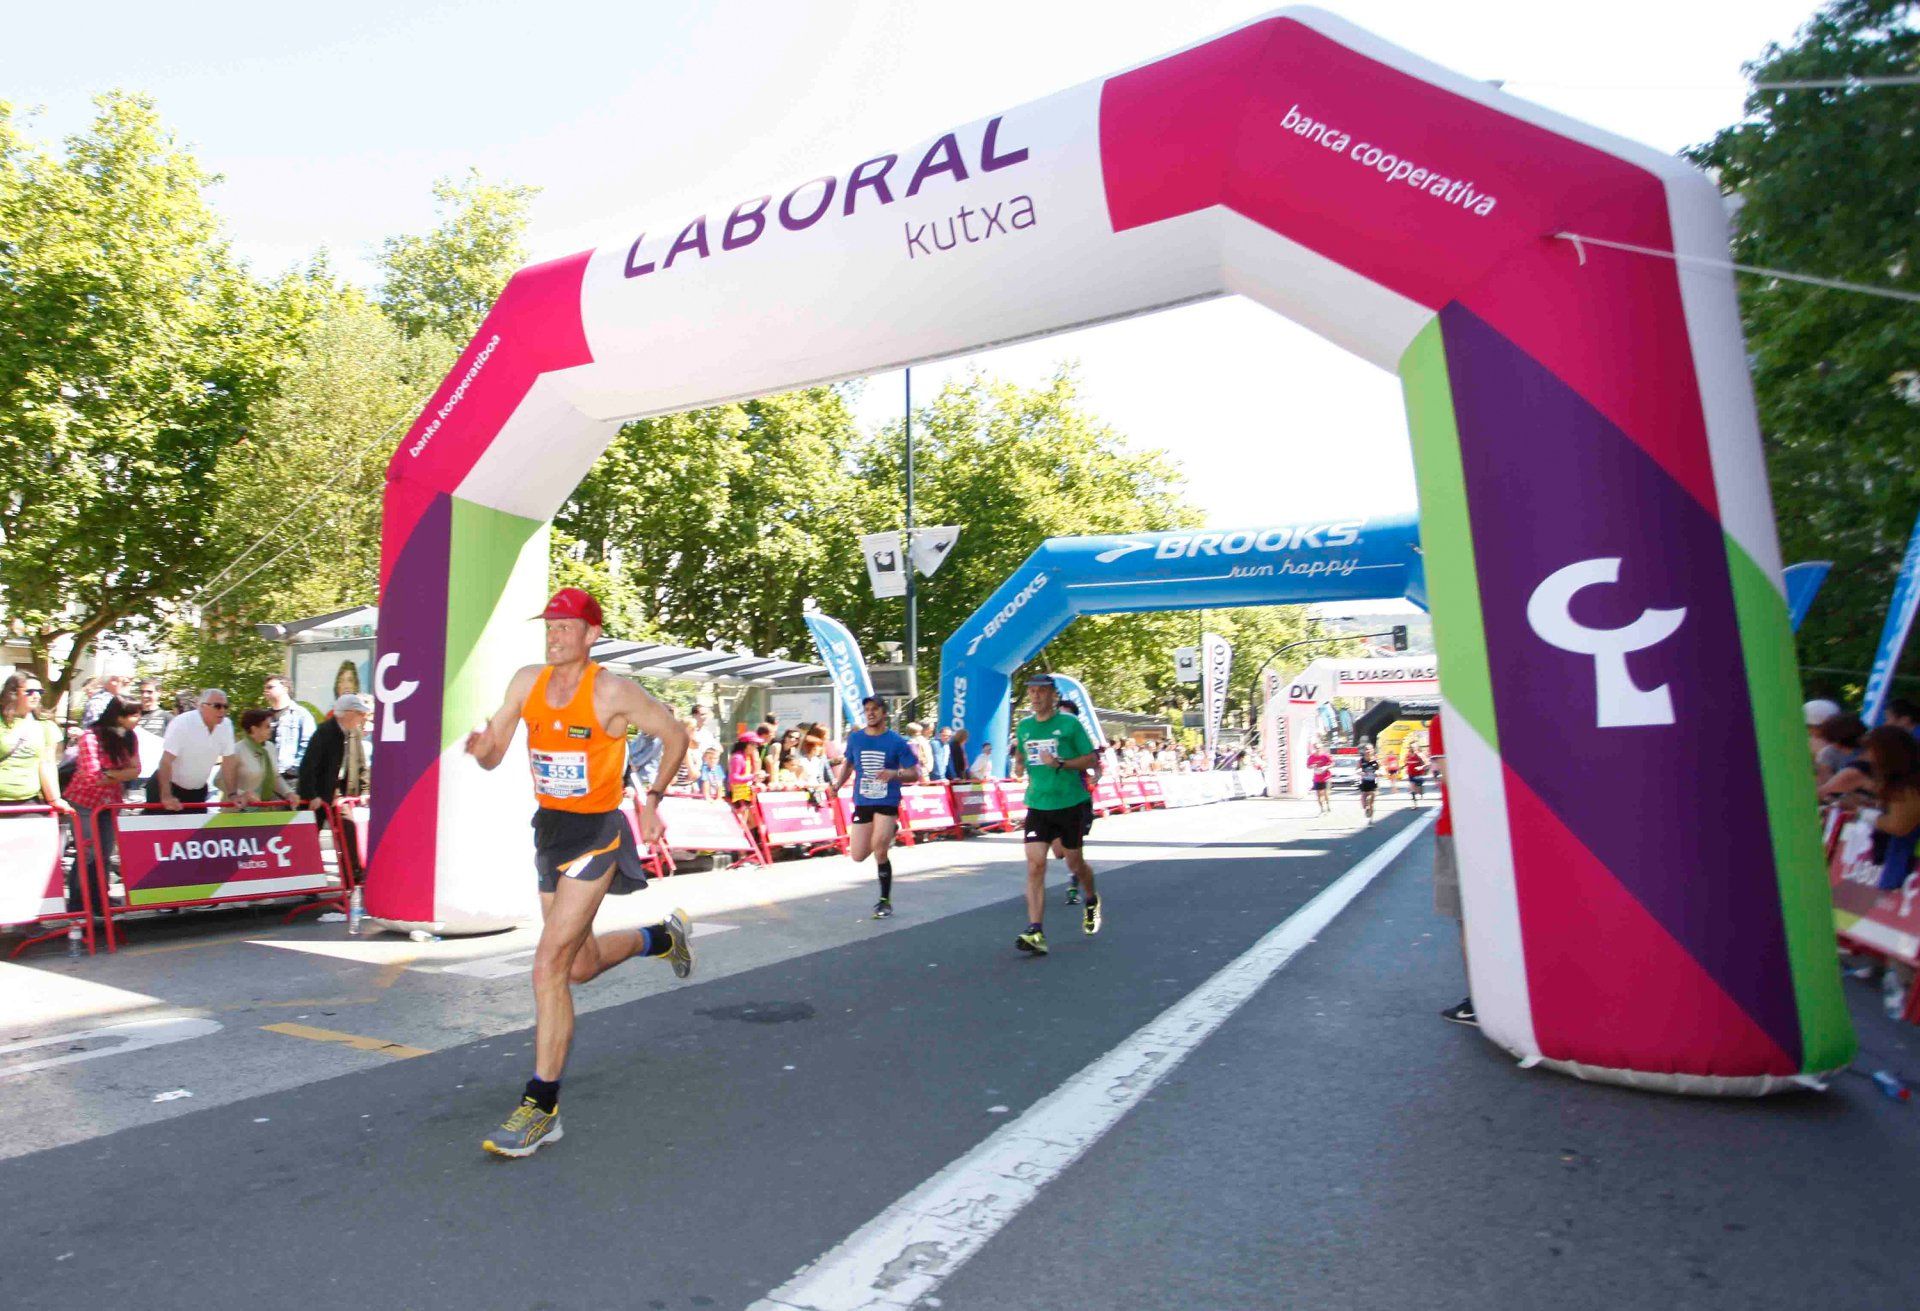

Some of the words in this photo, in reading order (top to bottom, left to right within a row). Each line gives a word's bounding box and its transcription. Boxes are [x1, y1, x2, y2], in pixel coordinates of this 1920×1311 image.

[1280, 104, 1351, 153] banca
[1350, 142, 1498, 217] cooperativa
[624, 116, 1029, 279] LABORAL
[904, 195, 1036, 259] kutxa
[408, 419, 441, 457] banka
[438, 334, 501, 419] kooperatiboa
[1154, 519, 1363, 560] BROOKS
[1229, 564, 1274, 578] run
[1281, 557, 1359, 578] happy
[983, 571, 1049, 639] BROOKS
[1290, 685, 1319, 700] DV
[1340, 671, 1354, 680] EL
[1407, 668, 1437, 679] VAS
[951, 676, 967, 735] OOKS
[549, 765, 578, 779] 553
[153, 838, 266, 862] LABORAL
